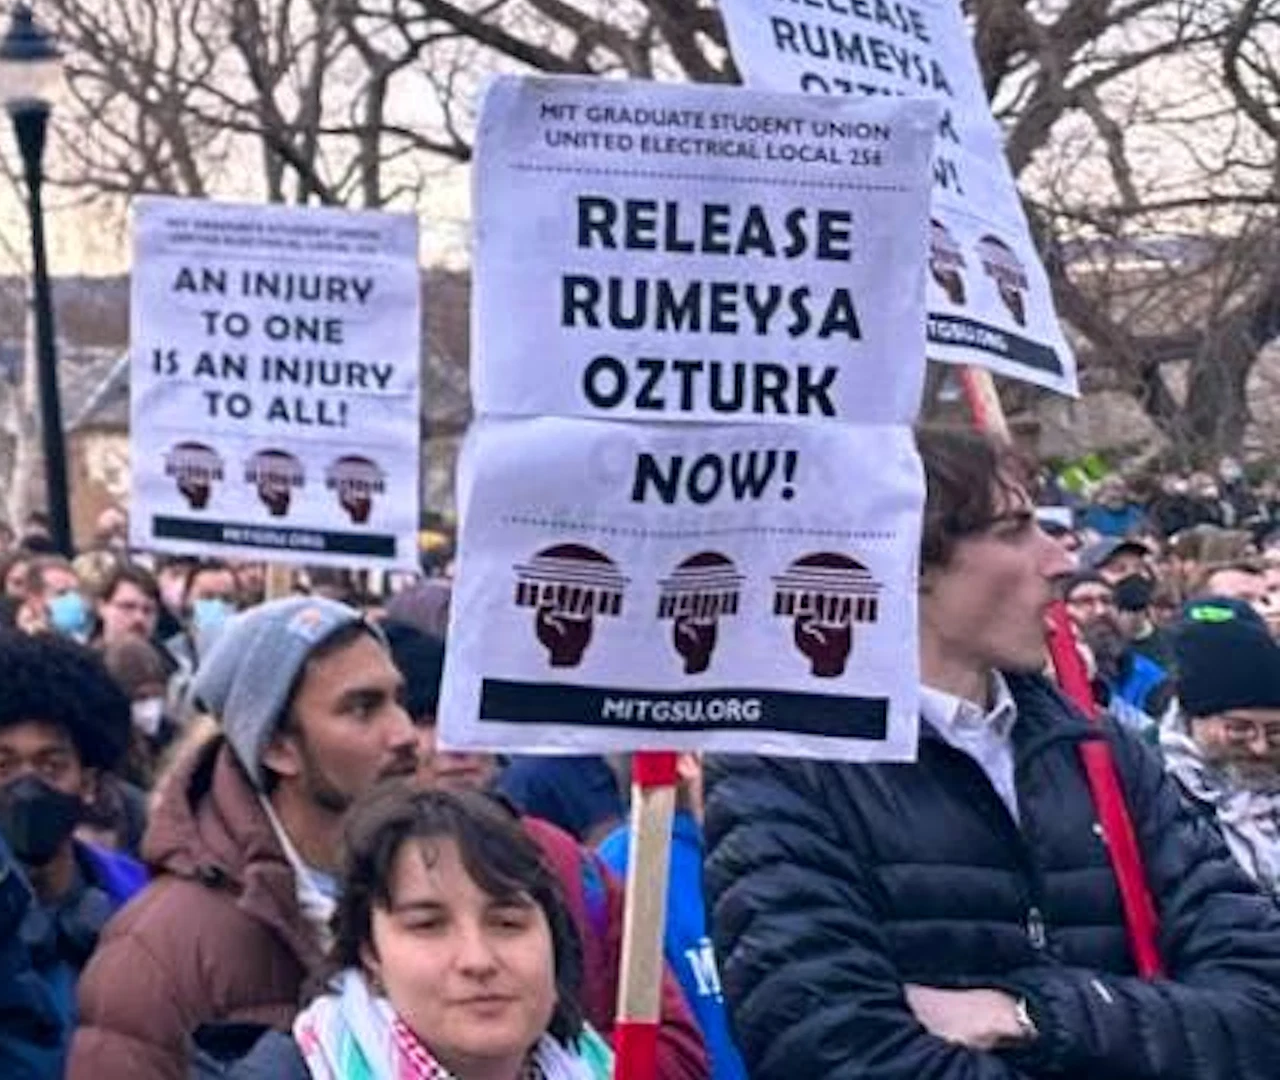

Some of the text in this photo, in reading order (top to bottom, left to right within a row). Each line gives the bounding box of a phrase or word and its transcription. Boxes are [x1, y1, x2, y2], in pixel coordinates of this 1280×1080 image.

[771, 16, 952, 96] RUMEYSA
[540, 103, 889, 141] MIT GRADUATE STUDENT UNION
[545, 130, 633, 151] UNITED
[641, 135, 760, 159] ELECTRICAL
[766, 144, 842, 164] LOCAL
[577, 195, 854, 262] RELEASE
[173, 268, 374, 304] AN INJURY
[560, 274, 863, 341] RUMEYSA
[201, 311, 344, 344] TO ONE
[152, 350, 393, 389] IS AN INJURY
[583, 355, 838, 417] OZTURK
[203, 392, 348, 428] TO ALL!
[631, 450, 799, 505] NOW!
[601, 696, 761, 721] MITGSU.ORG
